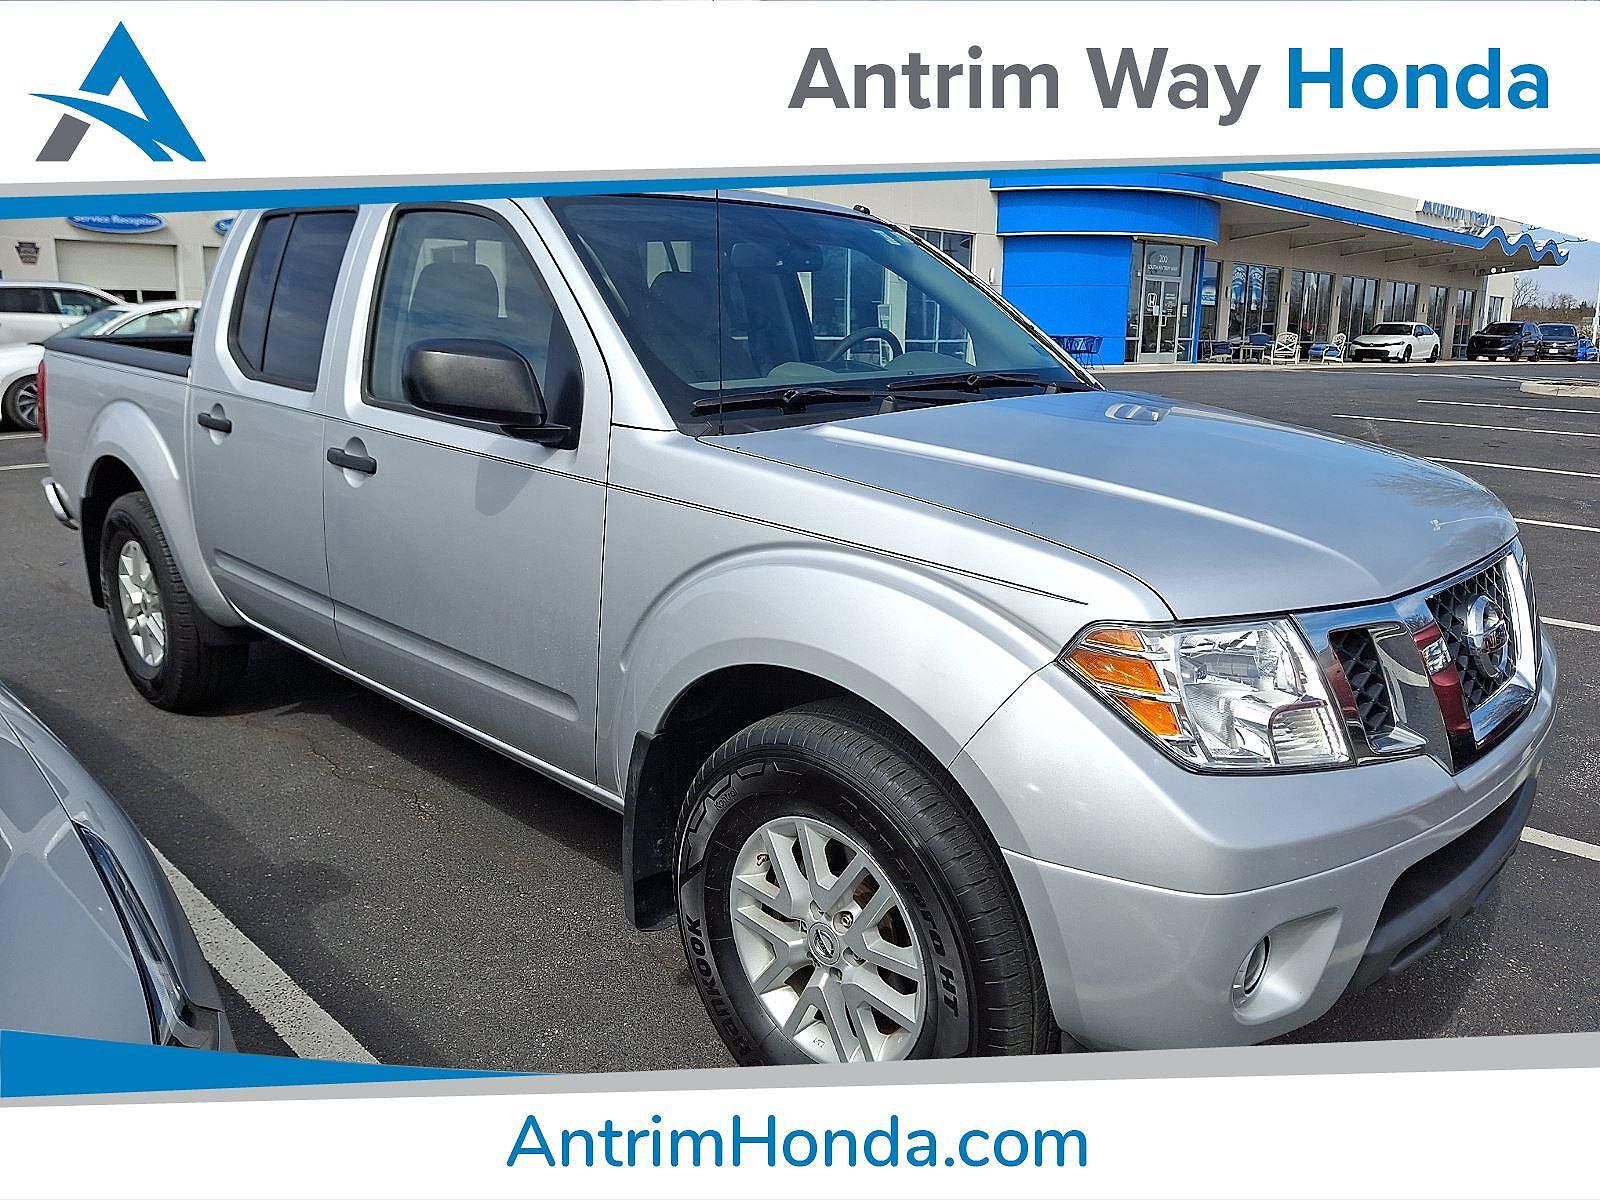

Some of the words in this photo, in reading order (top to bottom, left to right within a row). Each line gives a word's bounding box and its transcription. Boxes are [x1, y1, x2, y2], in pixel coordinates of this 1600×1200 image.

[72, 214, 110, 224] Service
[111, 213, 161, 226] Reception
[938, 963, 959, 1018] HT
